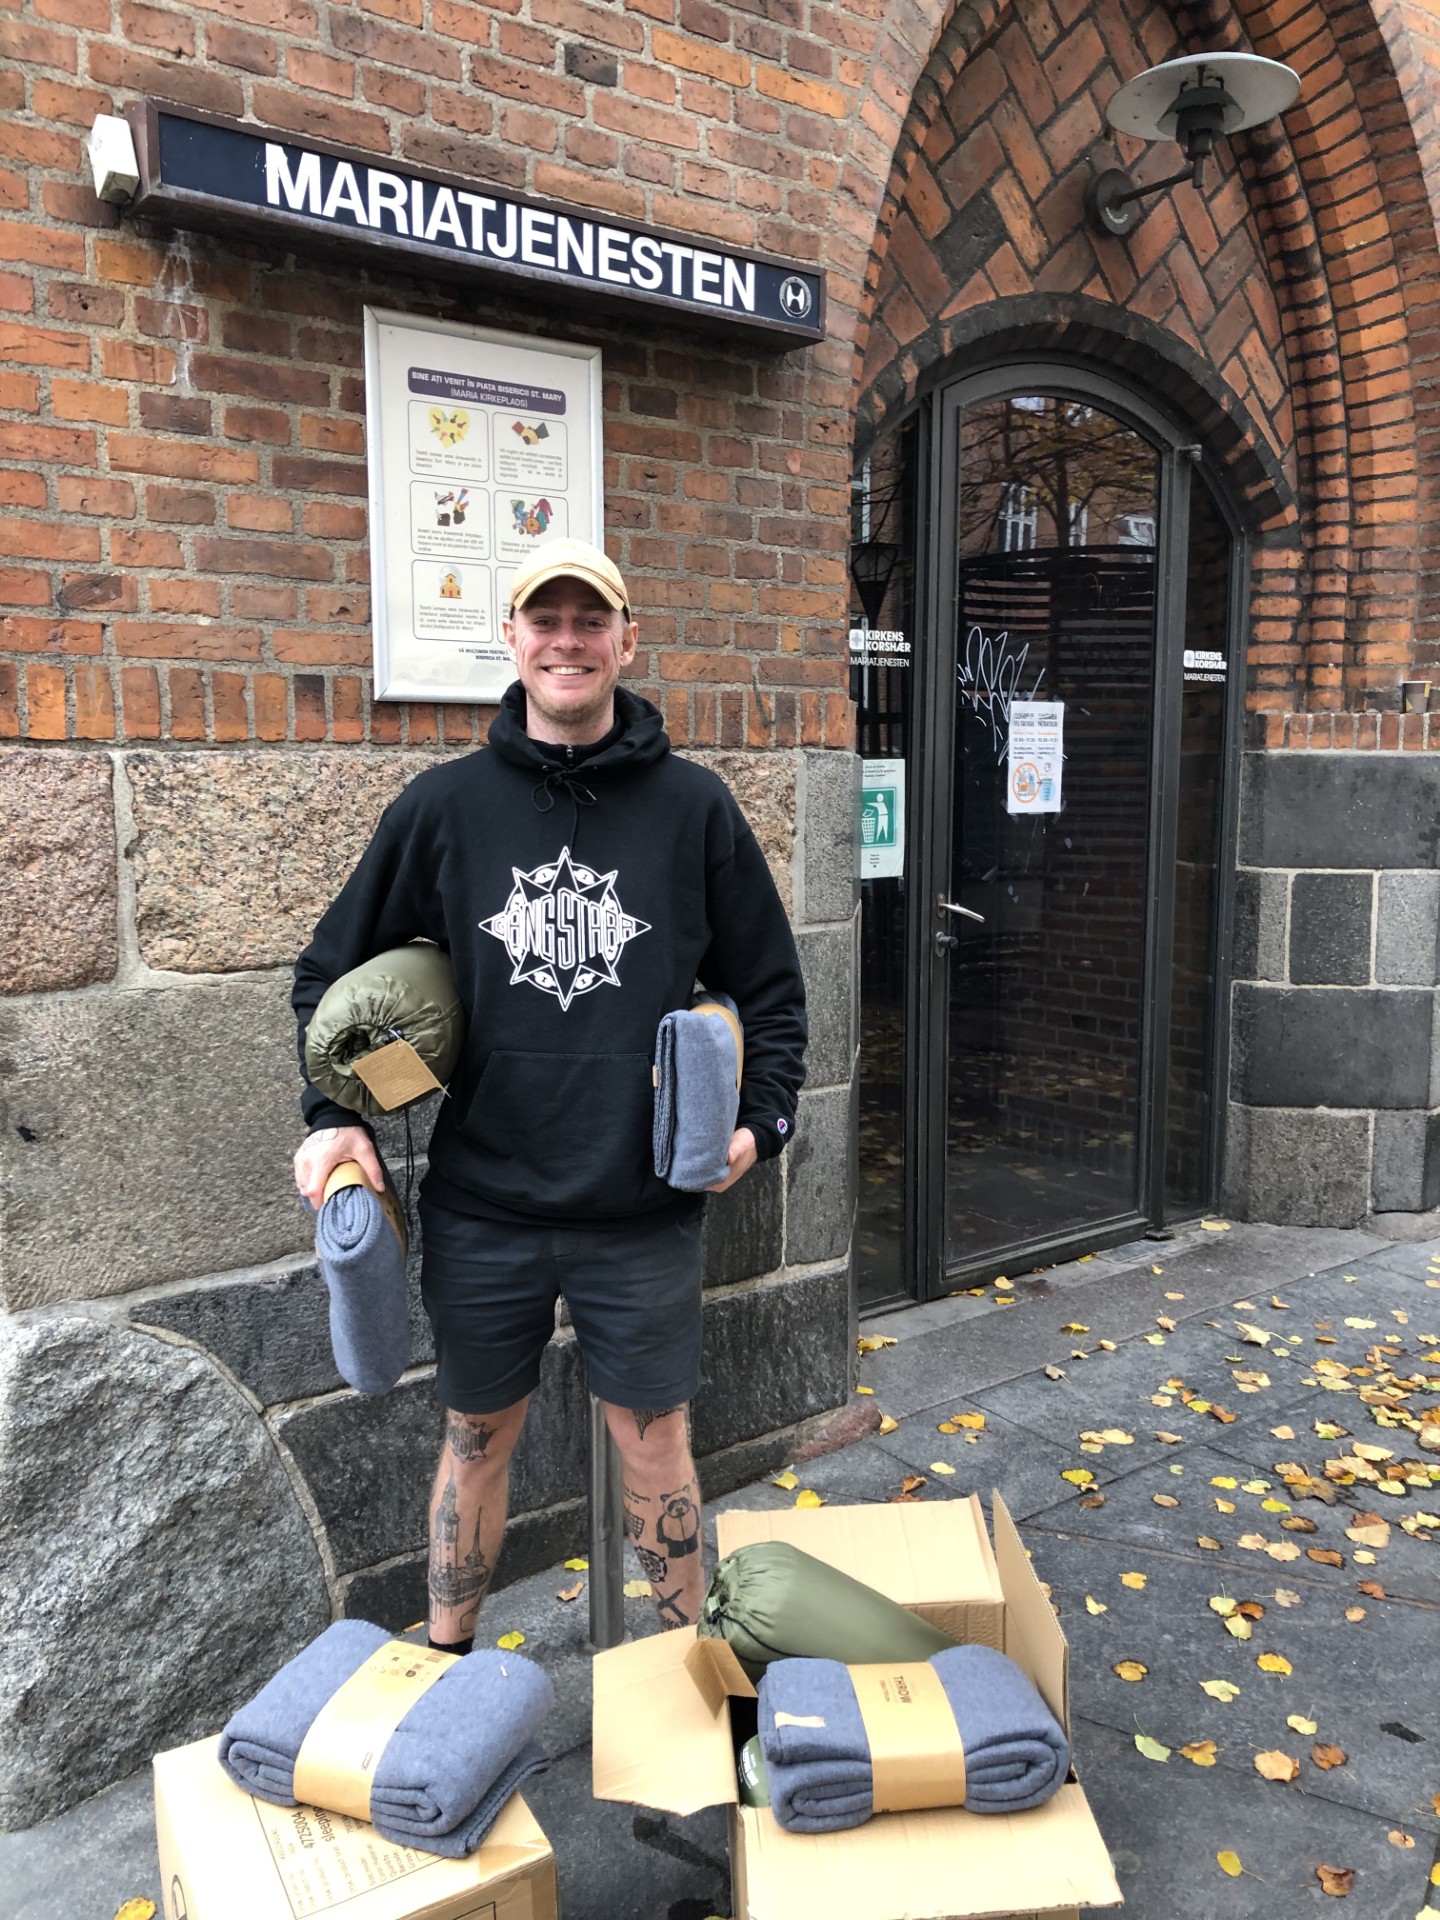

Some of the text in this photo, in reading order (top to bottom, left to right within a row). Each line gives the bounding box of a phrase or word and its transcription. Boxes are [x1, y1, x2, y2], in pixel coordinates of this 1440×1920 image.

[265, 142, 755, 312] MARIATJENESTEN
[412, 371, 429, 381] BINE
[444, 376, 465, 387] VENIT
[498, 384, 530, 397] BISERICII
[542, 391, 562, 402] MARY
[450, 387, 528, 408] (MARIA KIRKEPLADS)
[865, 629, 905, 642] KIRKENS
[865, 640, 911, 652] KORSHÆR
[850, 656, 910, 667] MARIATJENESTEN
[1194, 650, 1223, 661] KIRKENS
[1194, 660, 1227, 670] KORSHÆR
[1184, 672, 1226, 682] MARIATJENESTEN
[893, 1675, 912, 1704] THROW
[291, 1811, 316, 1849] 4725004
[405, 1852, 416, 1869] Gross
